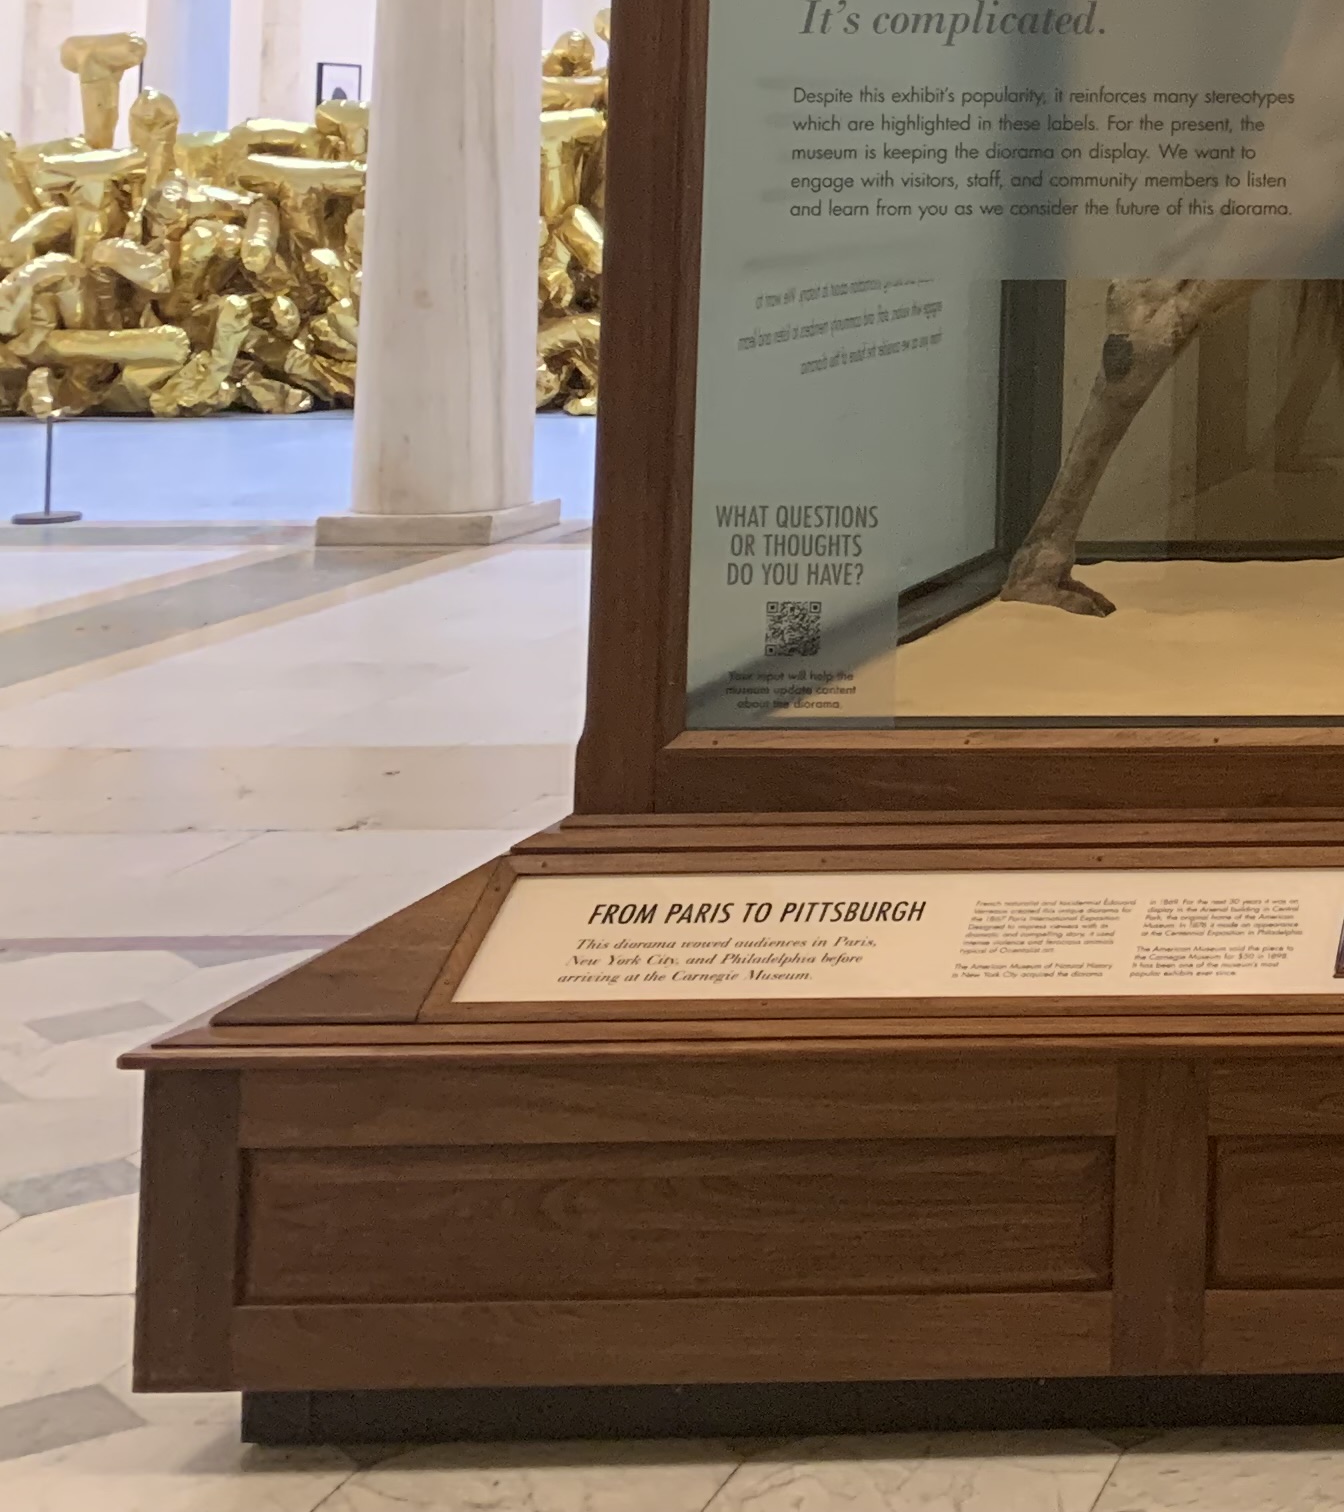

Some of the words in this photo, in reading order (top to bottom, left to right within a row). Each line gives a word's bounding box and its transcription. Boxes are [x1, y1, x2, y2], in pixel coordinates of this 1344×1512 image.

[798, 0, 860, 34] It's
[872, 0, 1106, 46] complicated.
[793, 86, 853, 108] Despite
[859, 85, 885, 103] this
[890, 85, 955, 103] exhibit's
[961, 85, 1046, 108] popularity,
[1054, 87, 1063, 102] it
[1069, 85, 1147, 104] reinforces
[1153, 91, 1198, 108] many
[1204, 89, 1295, 108] stereotypes
[792, 113, 841, 131] which
[846, 119, 875, 131] are
[880, 113, 971, 136] highlighted
[977, 115, 992, 130] in
[998, 113, 1040, 131] these
[1047, 113, 1099, 131] labels.
[1107, 114, 1133, 131] For
[1138, 113, 1164, 131] the
[1170, 117, 1232, 136] present,
[1240, 114, 1264, 131] the
[791, 148, 857, 160] museum
[864, 144, 876, 160] is
[882, 141, 948, 164] keeping
[954, 141, 979, 159] the
[984, 141, 1054, 159] diorama
[1060, 147, 1082, 159] on
[1088, 141, 1151, 164] display.
[1158, 143, 1188, 159] We
[1194, 145, 1235, 160] want
[1240, 145, 1256, 159] to
[790, 176, 854, 193] engage
[860, 169, 894, 187] with
[900, 172, 958, 189] visitors,
[966, 169, 1003, 189] staff,
[1010, 169, 1043, 187] and
[1048, 172, 1138, 191] community
[1144, 170, 1219, 188] members
[1225, 173, 1240, 187] to
[1246, 170, 1286, 187] listen
[789, 198, 822, 216] and
[828, 198, 869, 216] learn
[875, 197, 912, 216] from
[917, 204, 948, 220] you
[953, 204, 973, 216] as
[979, 204, 1003, 215] we
[1009, 197, 1078, 215] consider
[1084, 198, 1109, 215] the
[1115, 197, 1160, 215] future
[1165, 197, 1183, 215] of
[1188, 197, 1214, 216] this
[1220, 197, 1292, 216] diorama.
[715, 504, 768, 527] WHAT
[775, 504, 878, 528] QUESTIONS
[730, 533, 755, 556] OR
[763, 533, 862, 557] THOUGHTS
[726, 562, 753, 585] DO
[761, 562, 798, 586] YOU
[806, 562, 863, 585] HAVE?
[587, 903, 658, 924] FROM
[663, 902, 734, 924] PARIS
[742, 901, 772, 923] TO
[779, 900, 926, 922] PITTSBURGH
[576, 938, 609, 949] This
[612, 938, 676, 949] diorama
[680, 937, 732, 948] wowed
[733, 937, 807, 947] audiences
[811, 939, 827, 947] in
[833, 937, 876, 946] Paris,
